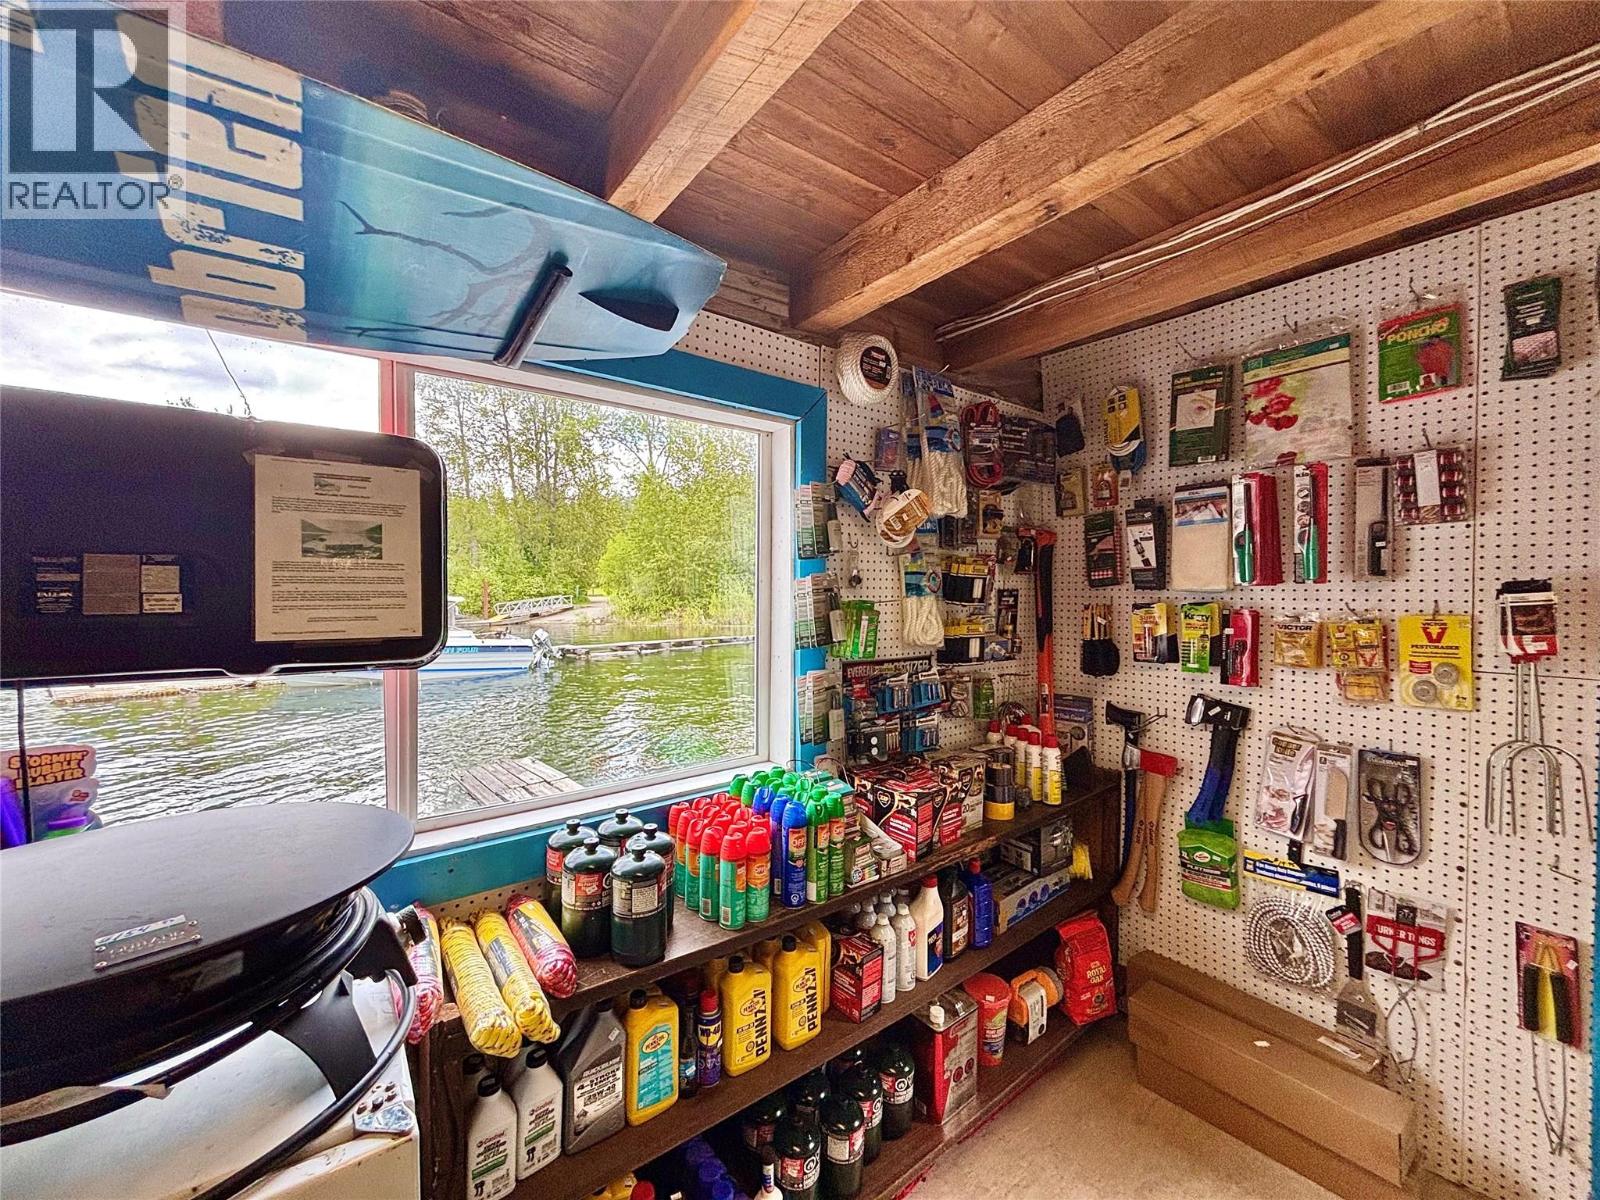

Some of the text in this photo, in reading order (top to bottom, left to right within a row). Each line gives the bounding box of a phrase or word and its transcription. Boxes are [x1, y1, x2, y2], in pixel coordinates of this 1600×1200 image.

[1387, 317, 1451, 345] PONCHO
[9, 751, 88, 769] SORMIN'
[962, 803, 970, 815] 20
[1406, 930, 1437, 947] TNGS
[700, 1025, 721, 1037] WD-40
